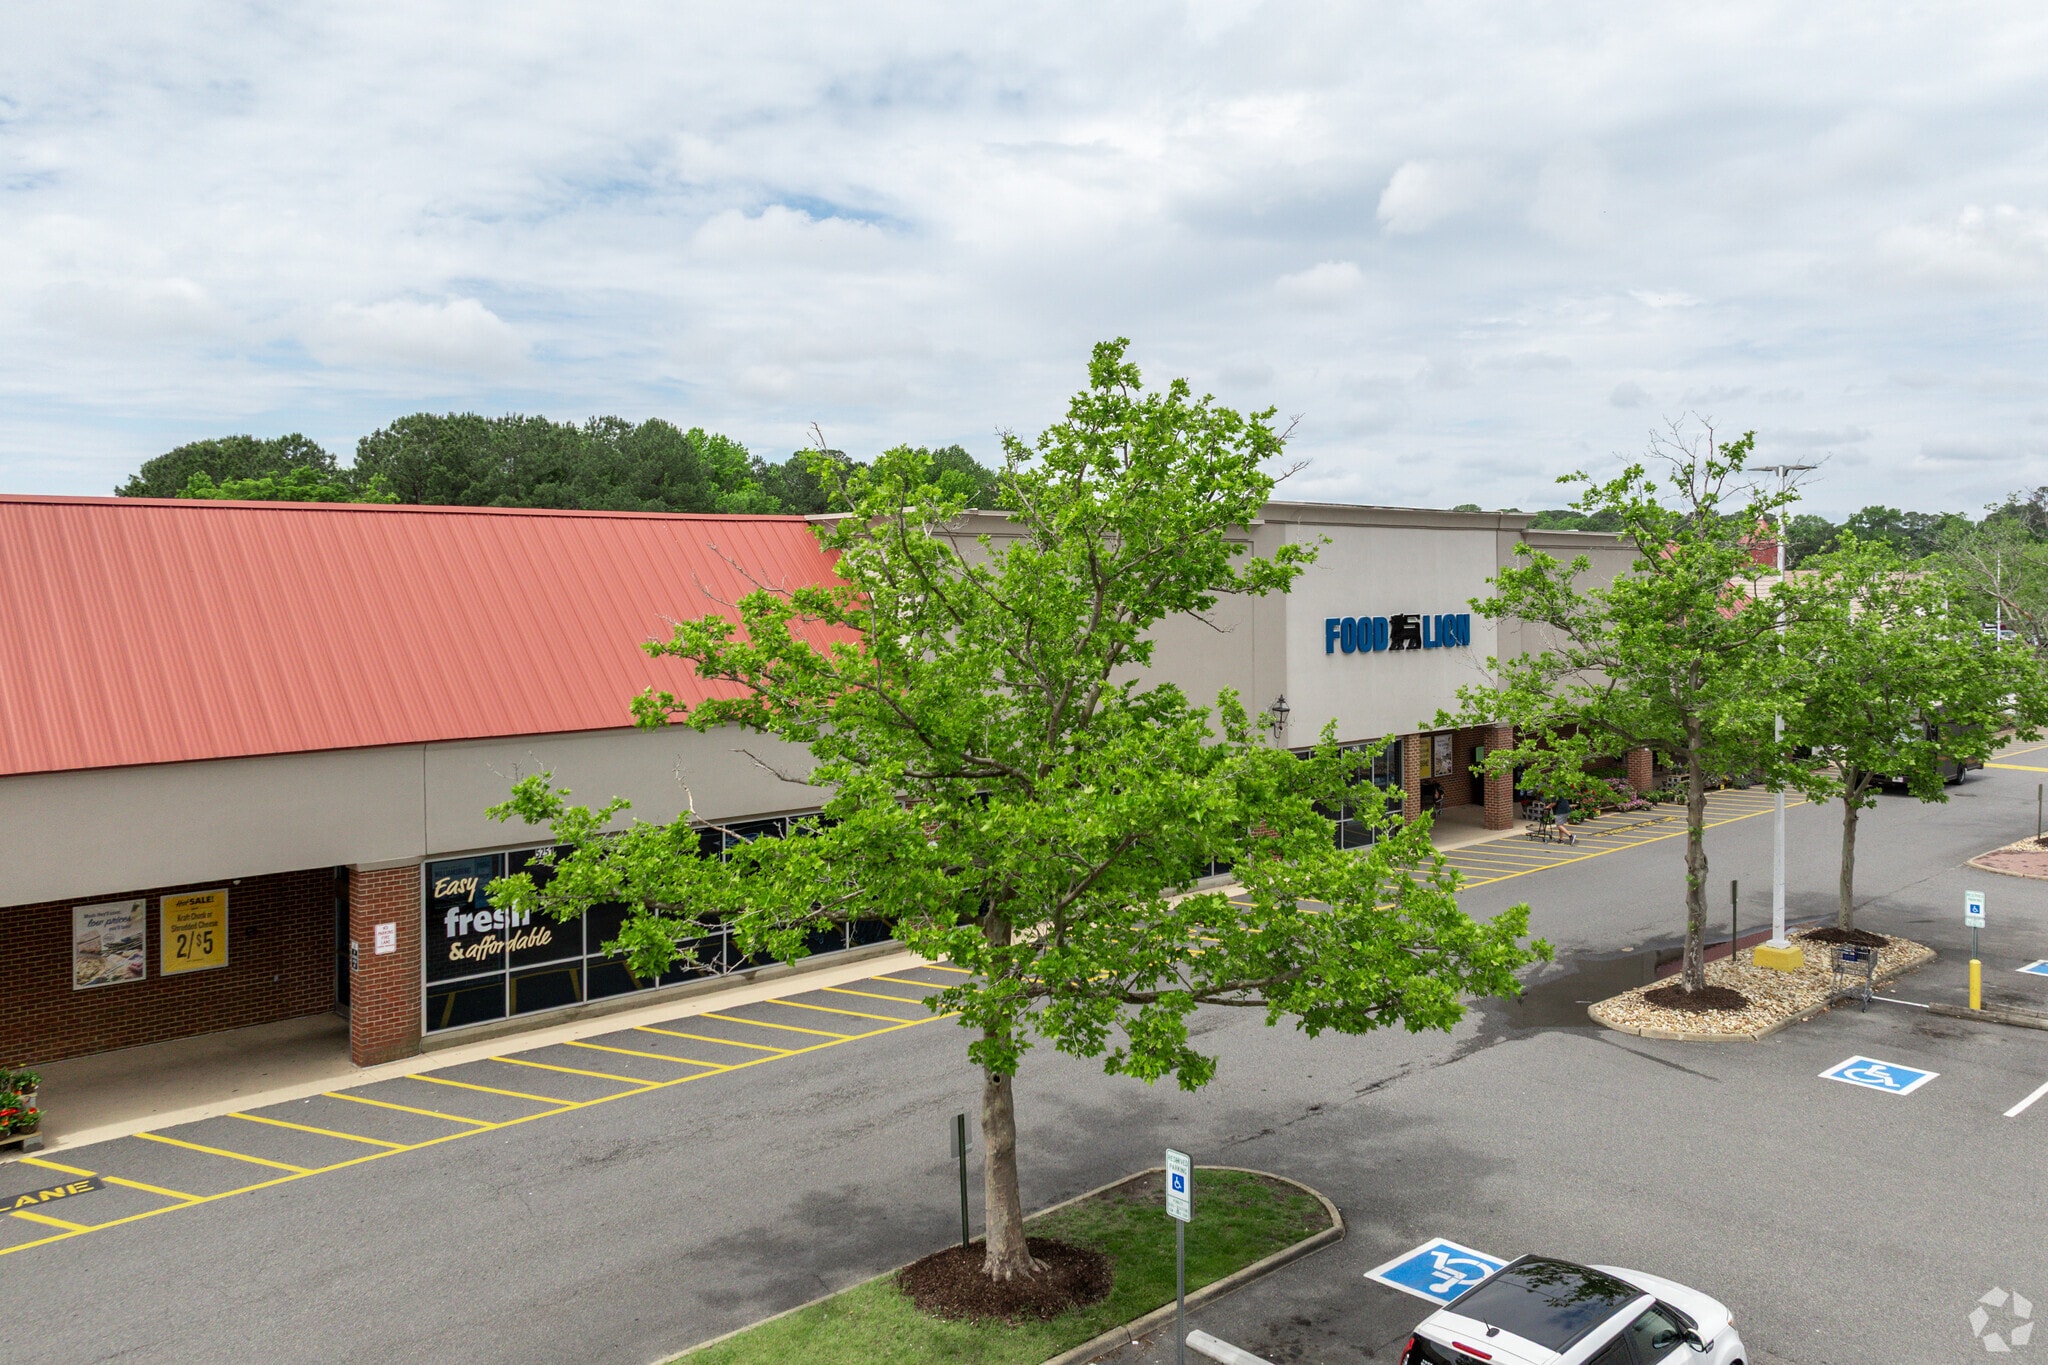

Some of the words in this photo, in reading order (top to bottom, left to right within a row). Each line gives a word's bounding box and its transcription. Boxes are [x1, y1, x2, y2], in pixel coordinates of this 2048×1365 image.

[1325, 616, 1389, 654] FOOD
[1423, 613, 1471, 649] LION
[189, 896, 214, 905] SALE!
[434, 877, 478, 903] Easy
